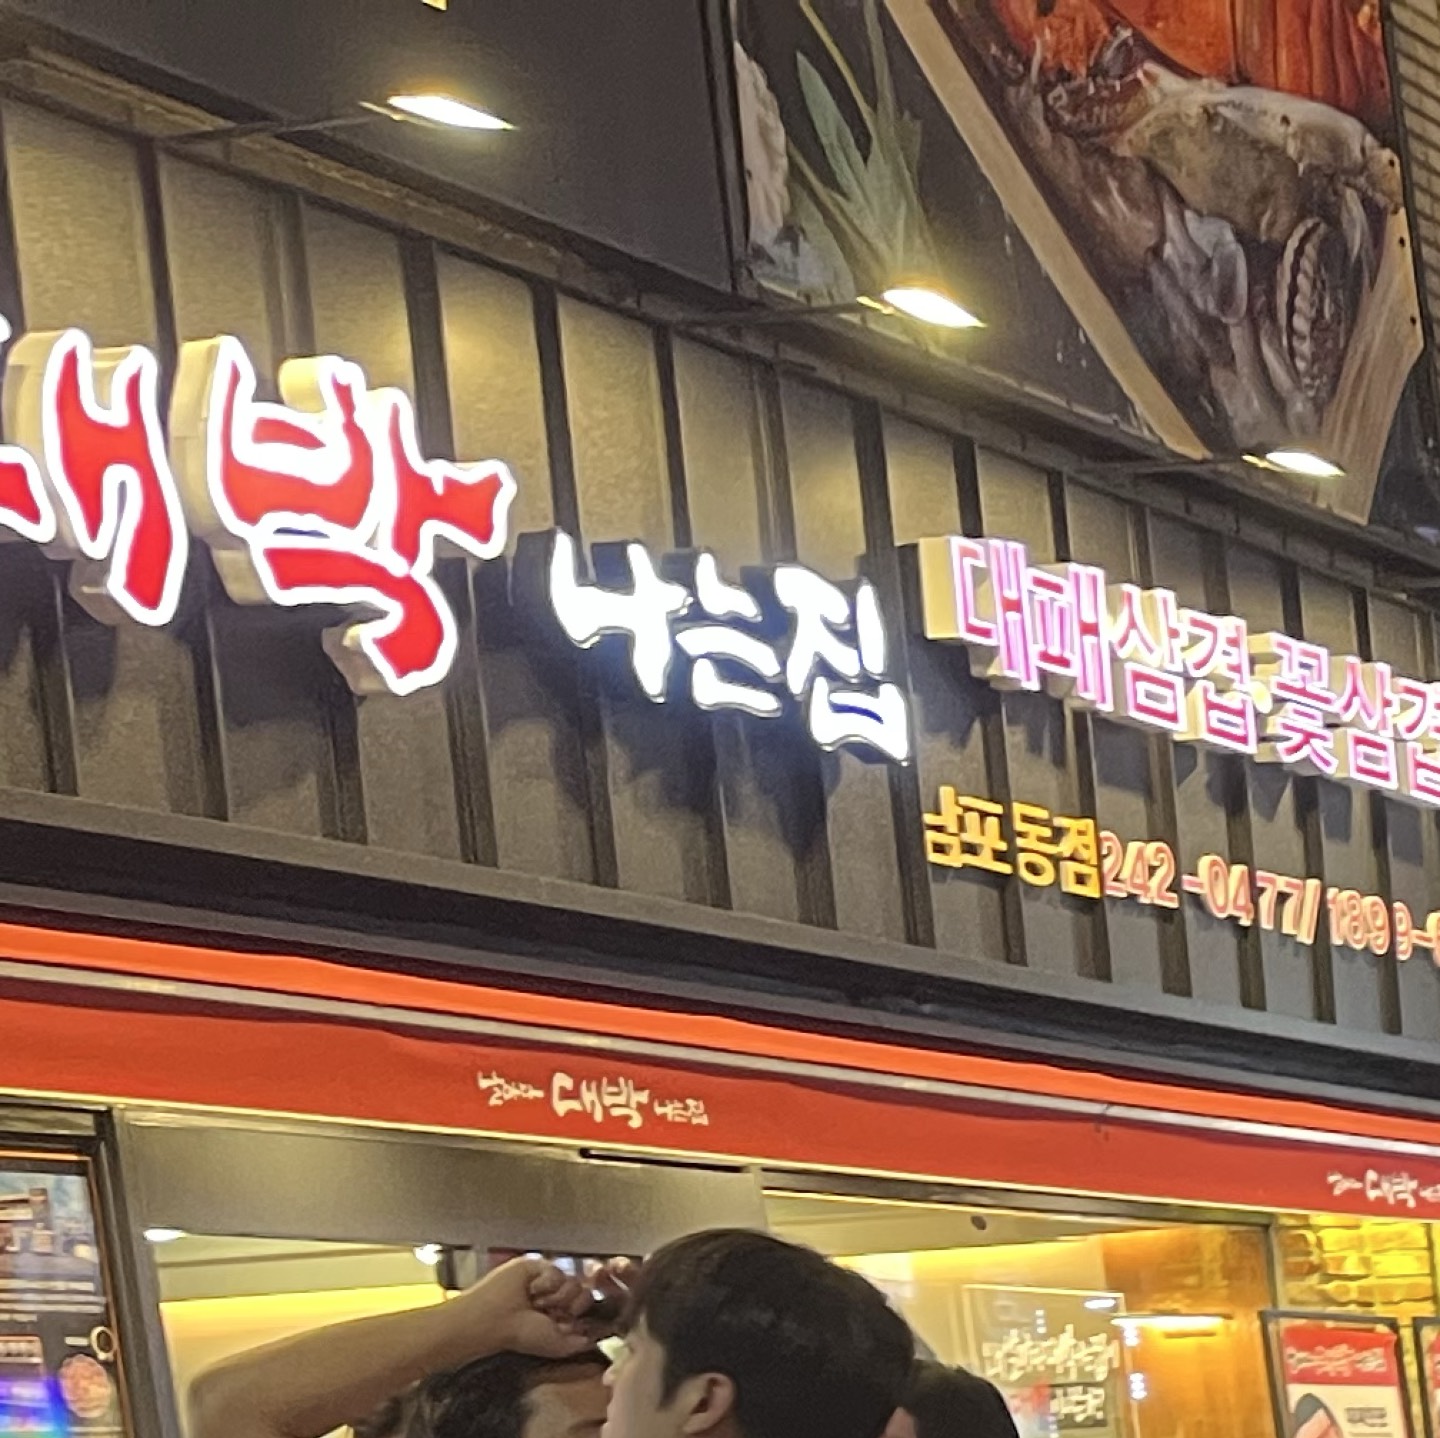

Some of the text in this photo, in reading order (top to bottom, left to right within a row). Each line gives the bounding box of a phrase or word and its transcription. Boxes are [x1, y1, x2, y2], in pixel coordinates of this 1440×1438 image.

[549, 528, 911, 766] 나는집
[923, 786, 1102, 899] 남포동점
[552, 1072, 651, 1129] 대박
